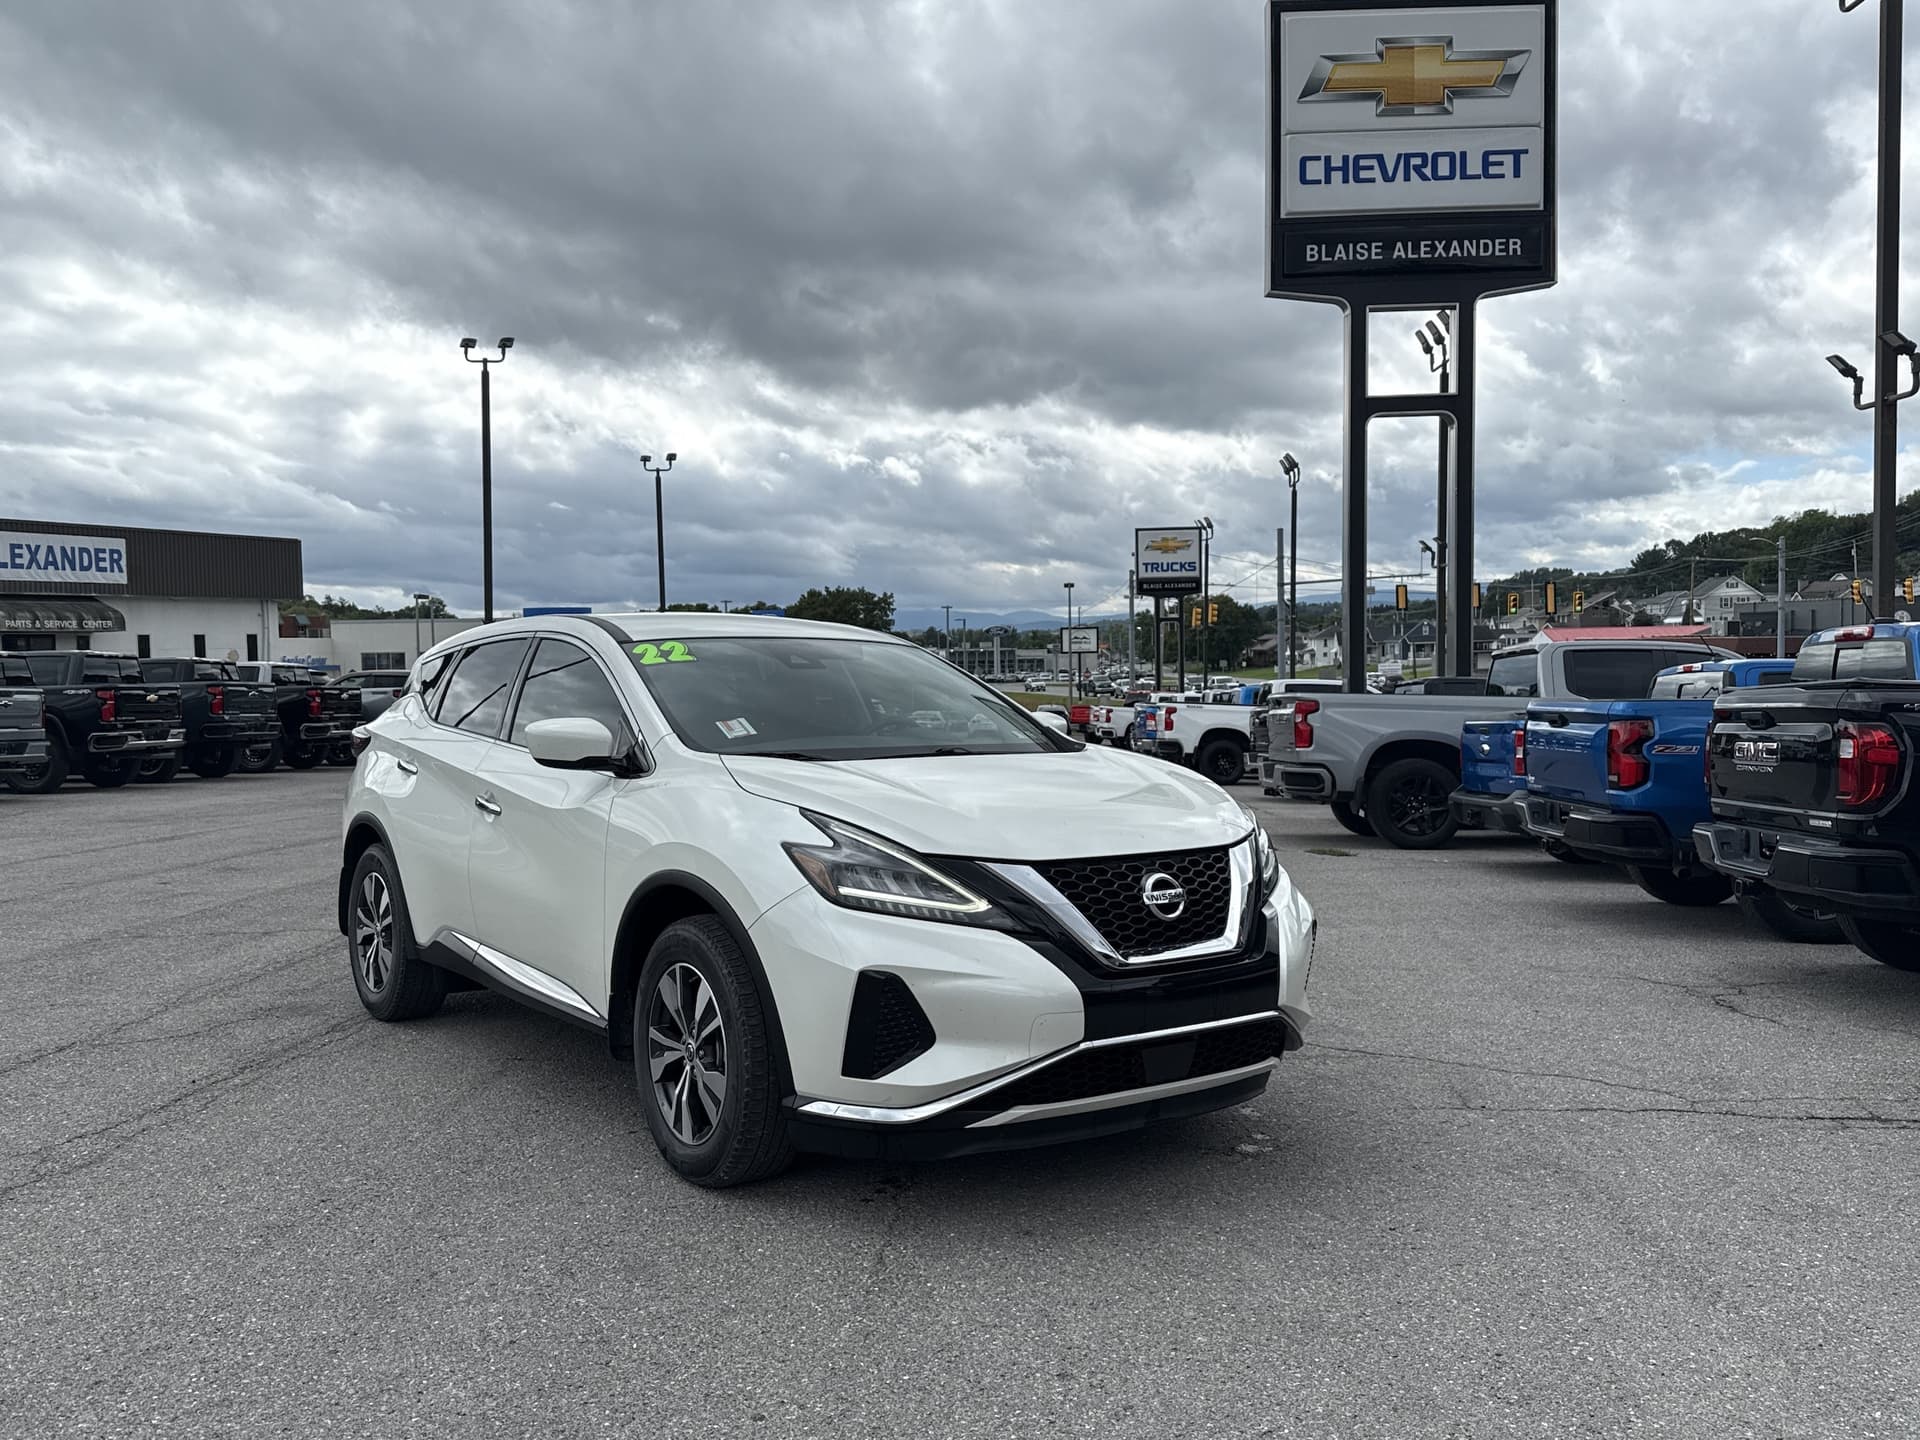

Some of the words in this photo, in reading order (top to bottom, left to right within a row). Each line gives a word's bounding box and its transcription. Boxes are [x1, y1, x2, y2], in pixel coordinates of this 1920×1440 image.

[1299, 148, 1529, 186] CHEVROLET
[1305, 242, 1384, 262] BLAISE
[1392, 238, 1522, 259] ALEXANDER
[1142, 561, 1197, 572] TRUCKS
[5, 620, 32, 629] PARTS
[35, 620, 41, 628] &
[44, 620, 78, 628] SERVICE
[82, 620, 113, 628] CENTER
[632, 641, 697, 665] 22
[1734, 741, 1778, 761] GMC
[1736, 765, 1774, 774] CANYON
[1150, 891, 1183, 902] NISSAN
